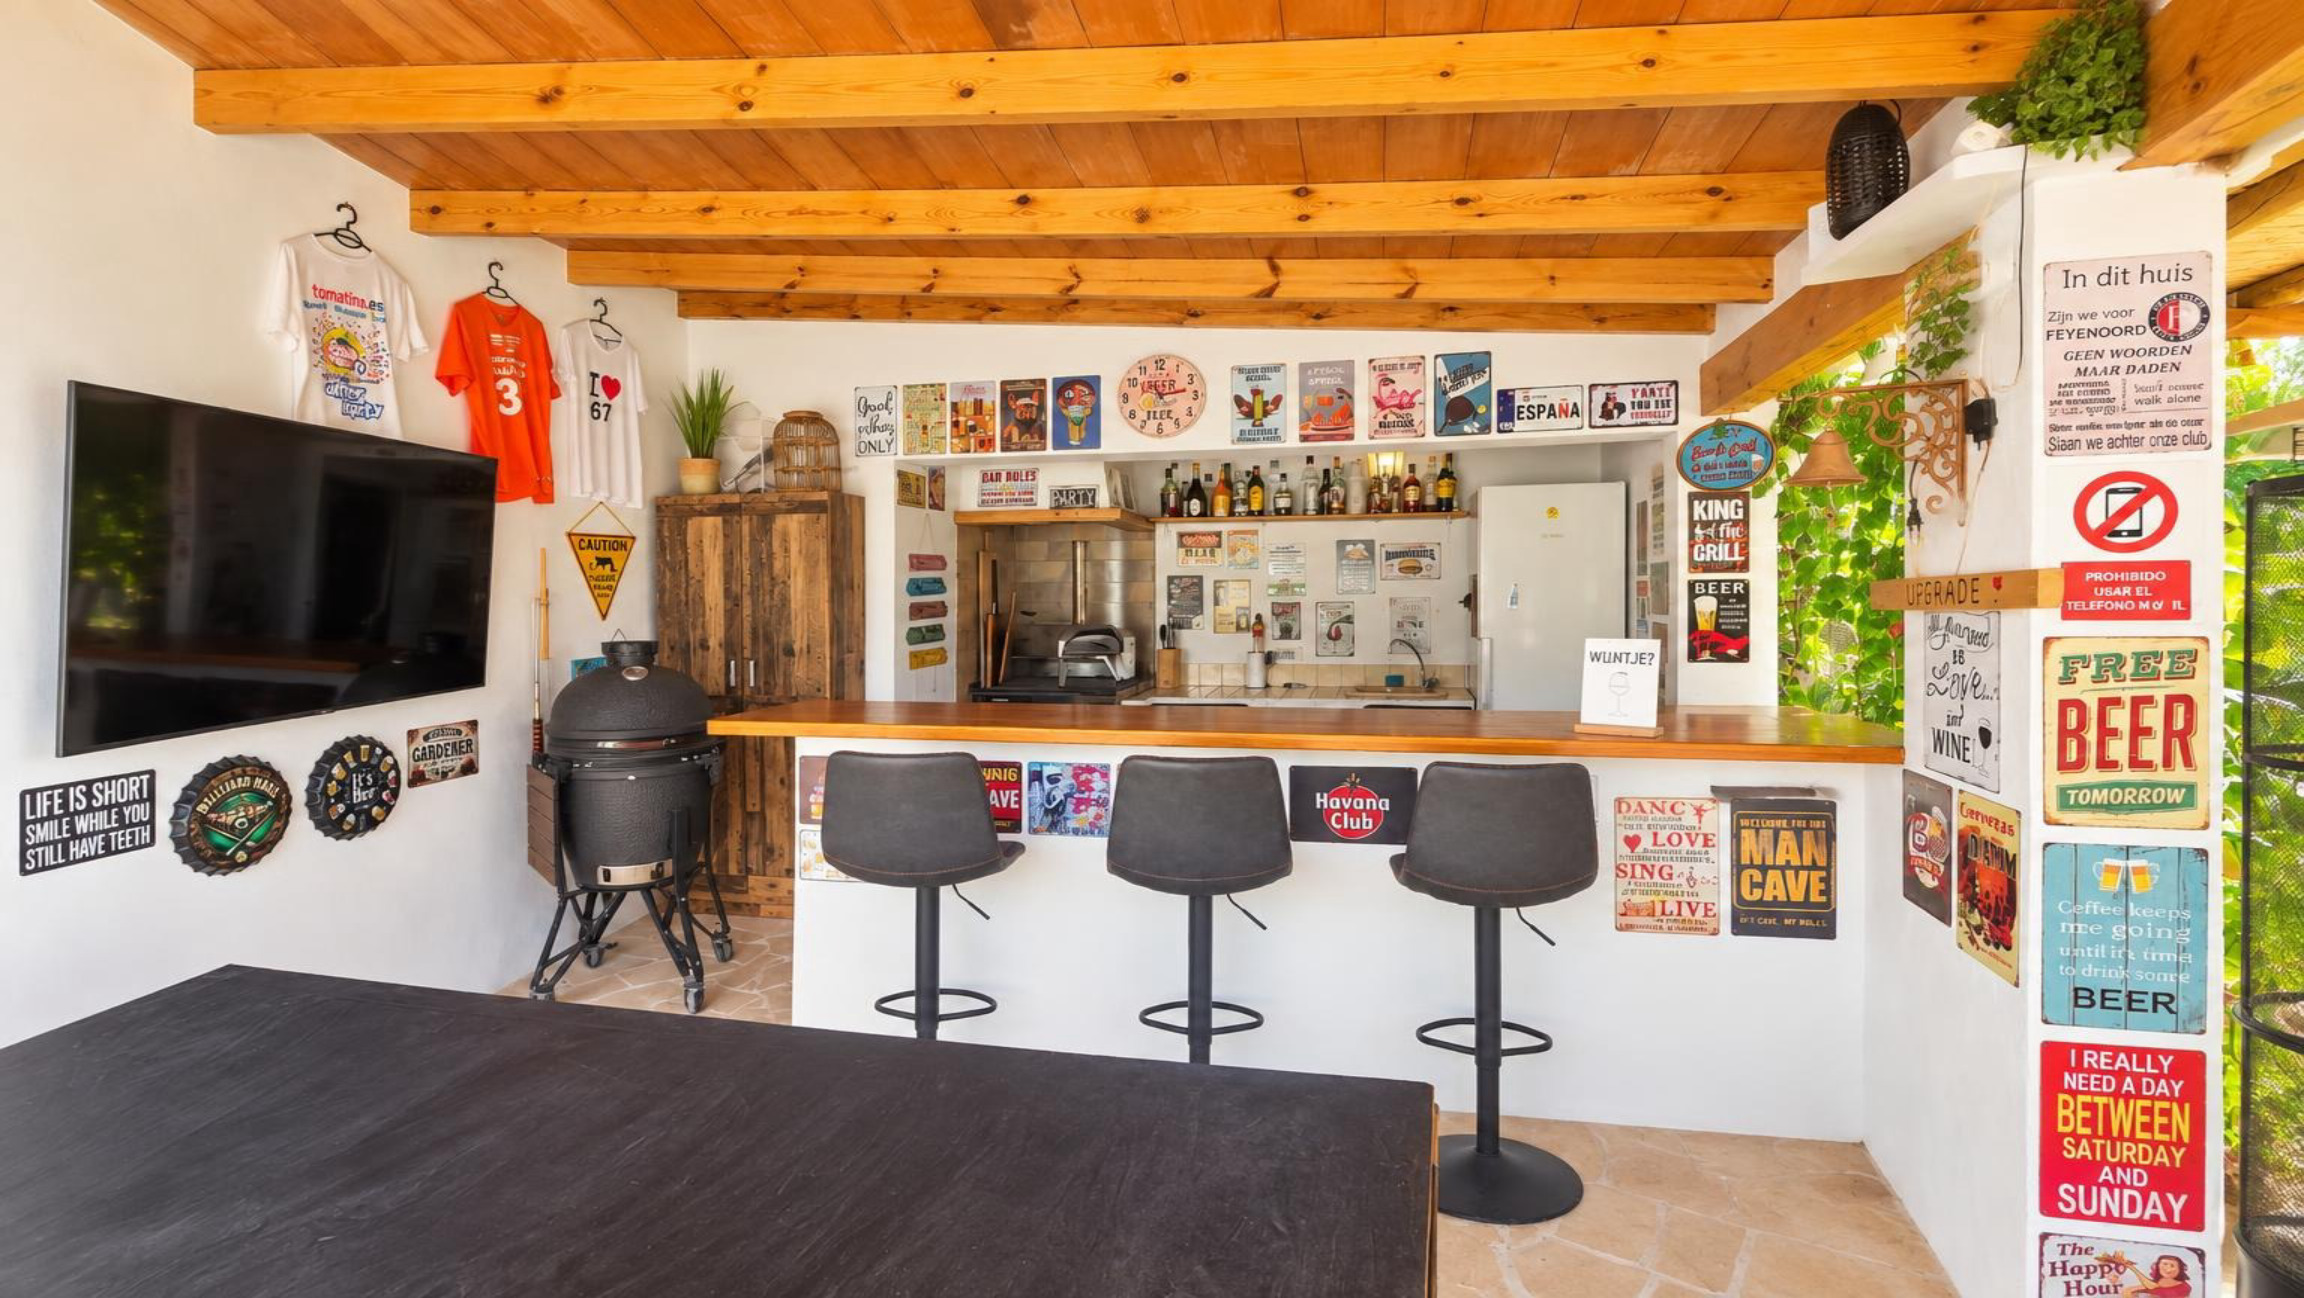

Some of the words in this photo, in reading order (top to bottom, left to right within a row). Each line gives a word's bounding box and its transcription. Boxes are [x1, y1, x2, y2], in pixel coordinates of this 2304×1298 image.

[2062, 268, 2087, 289] In
[2096, 265, 2130, 287] dit
[2139, 262, 2193, 285] huis
[2047, 311, 2073, 325] Zijn
[2077, 312, 2098, 321] we
[2046, 324, 2147, 341] FEYENOORD
[2063, 349, 2105, 362] GEEN
[2110, 344, 2193, 360] WOORDEN
[1154, 358, 1166, 371] 12
[2074, 364, 2121, 378] MAAR
[2125, 361, 2182, 375] DADEN
[589, 371, 600, 398] I
[495, 377, 523, 416] 3
[590, 401, 612, 422] 67
[1516, 398, 1581, 421] ESPAÑA
[857, 438, 894, 454] ONLY
[2085, 438, 2104, 449] we
[2107, 432, 2145, 449] achter
[1692, 499, 1744, 521] KING
[578, 538, 628, 552] CAUTION
[2085, 571, 2167, 582] PROHIBIDO
[1694, 581, 1745, 595] BEER
[2094, 586, 2131, 596] USAR
[2135, 586, 2152, 596] EL
[2058, 648, 2198, 685] FREE
[2056, 693, 2198, 774] BEER
[25, 789, 63, 820] LIFE
[69, 784, 87, 813] IS
[91, 774, 150, 807] SHORT
[989, 789, 1020, 809] AVE
[1315, 792, 1390, 811] Havana
[2066, 787, 2186, 806] TOMORROW
[25, 816, 71, 846] SMILE
[74, 808, 119, 835] WHILE
[122, 801, 150, 825] YOU
[1330, 812, 1374, 830] Club
[25, 842, 66, 870] STILL
[69, 833, 106, 861] HAVE
[108, 824, 151, 852] TEETH
[1651, 831, 1717, 848] LOVE
[1740, 828, 1828, 866] MAN
[1615, 862, 1674, 881] SING
[1740, 868, 1828, 902] CAVE
[1659, 899, 1717, 918] LIVE
[2130, 902, 2191, 921] keeps
[2111, 922, 2191, 944] going
[2059, 964, 2076, 976] to
[2073, 987, 2178, 1015] BEER
[2070, 1049, 2076, 1068] I
[2083, 1049, 2175, 1075] REALLY
[2063, 1072, 2116, 1093] NEED
[2121, 1076, 2136, 1095] A
[2142, 1078, 2184, 1098] DAY
[2057, 1093, 2191, 1144] BETWEEN
[2062, 1137, 2187, 1168] SATURDAY
[2098, 1166, 2148, 1187] AND
[2057, 1183, 2188, 1224] SUNDAY
[2057, 1242, 2095, 1256] The
[2063, 1281, 2123, 1297] Hour
